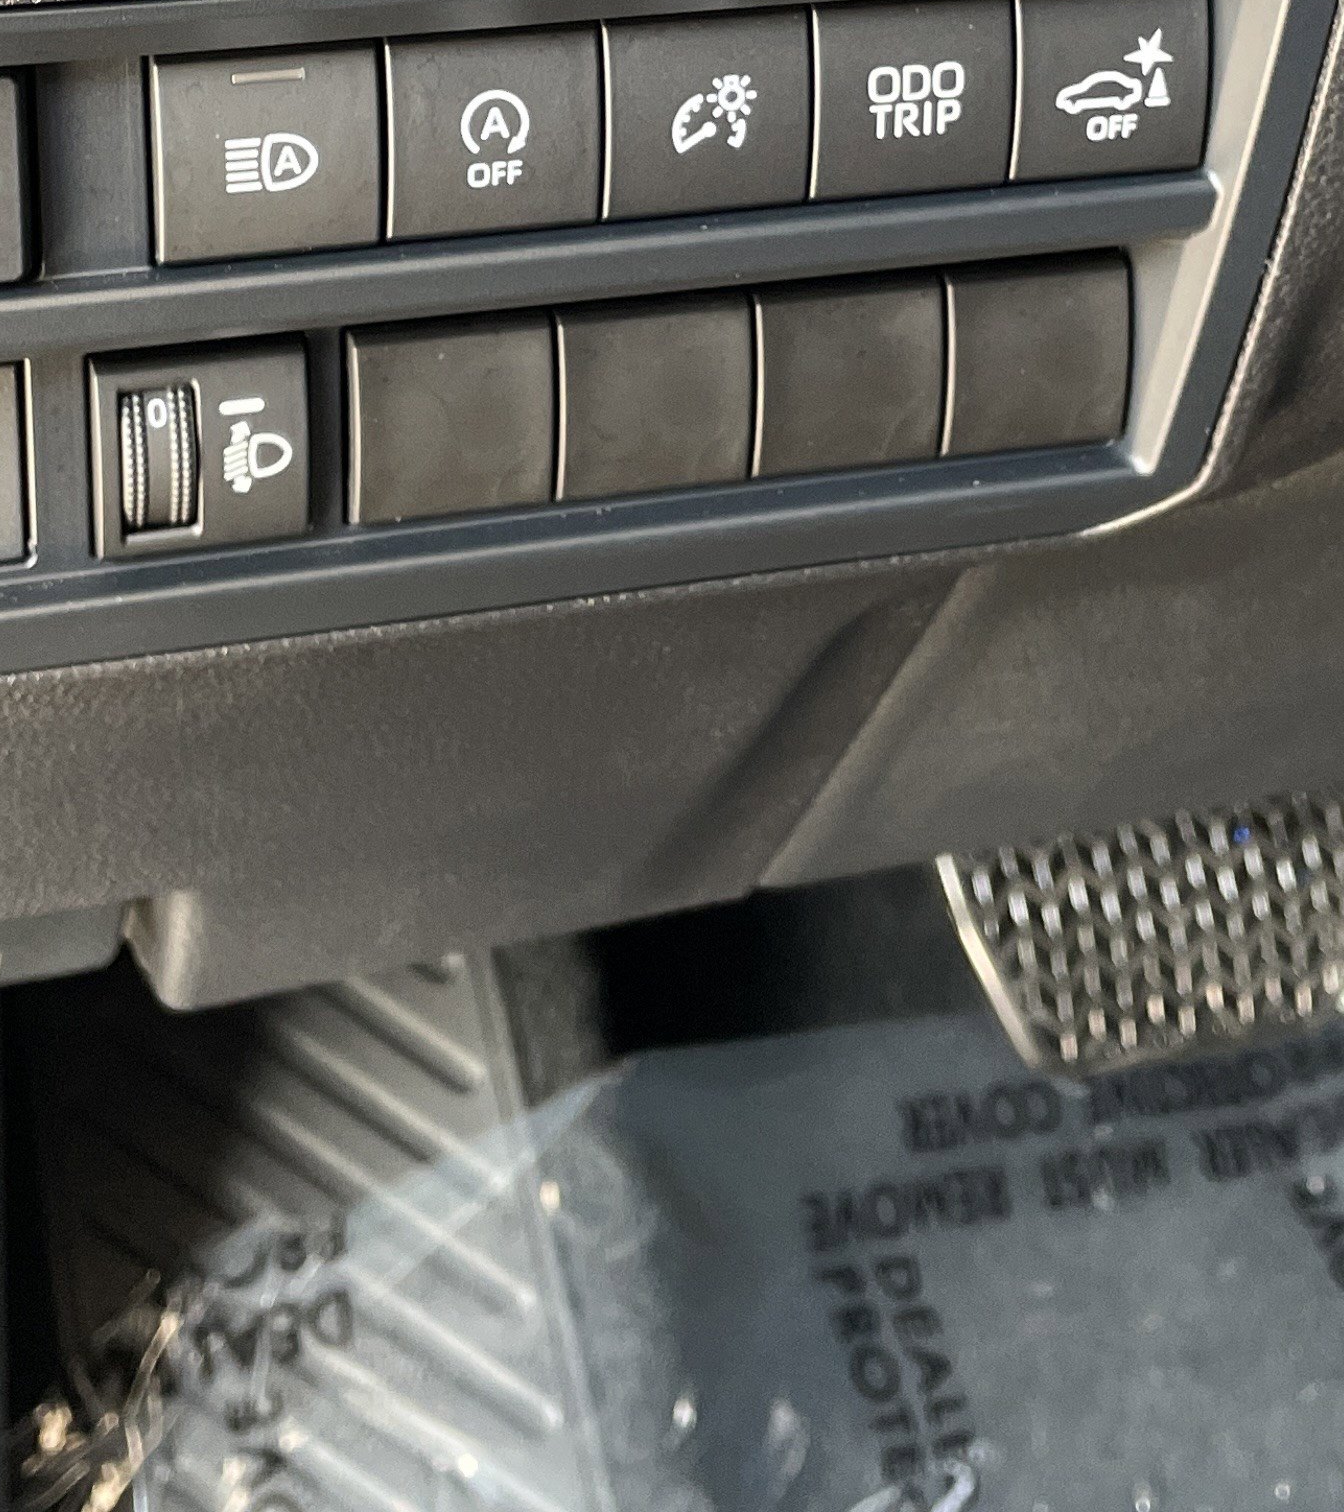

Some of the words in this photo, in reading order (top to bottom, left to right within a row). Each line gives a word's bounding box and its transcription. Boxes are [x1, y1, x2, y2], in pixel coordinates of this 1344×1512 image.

[867, 60, 966, 101] ODO
[480, 106, 510, 141] A
[869, 100, 962, 140] TRIP
[1086, 113, 1138, 142] OFF
[273, 145, 303, 177] A
[466, 159, 523, 189] OFF
[146, 397, 167, 429] 0
[899, 1080, 1061, 1153] COVER
